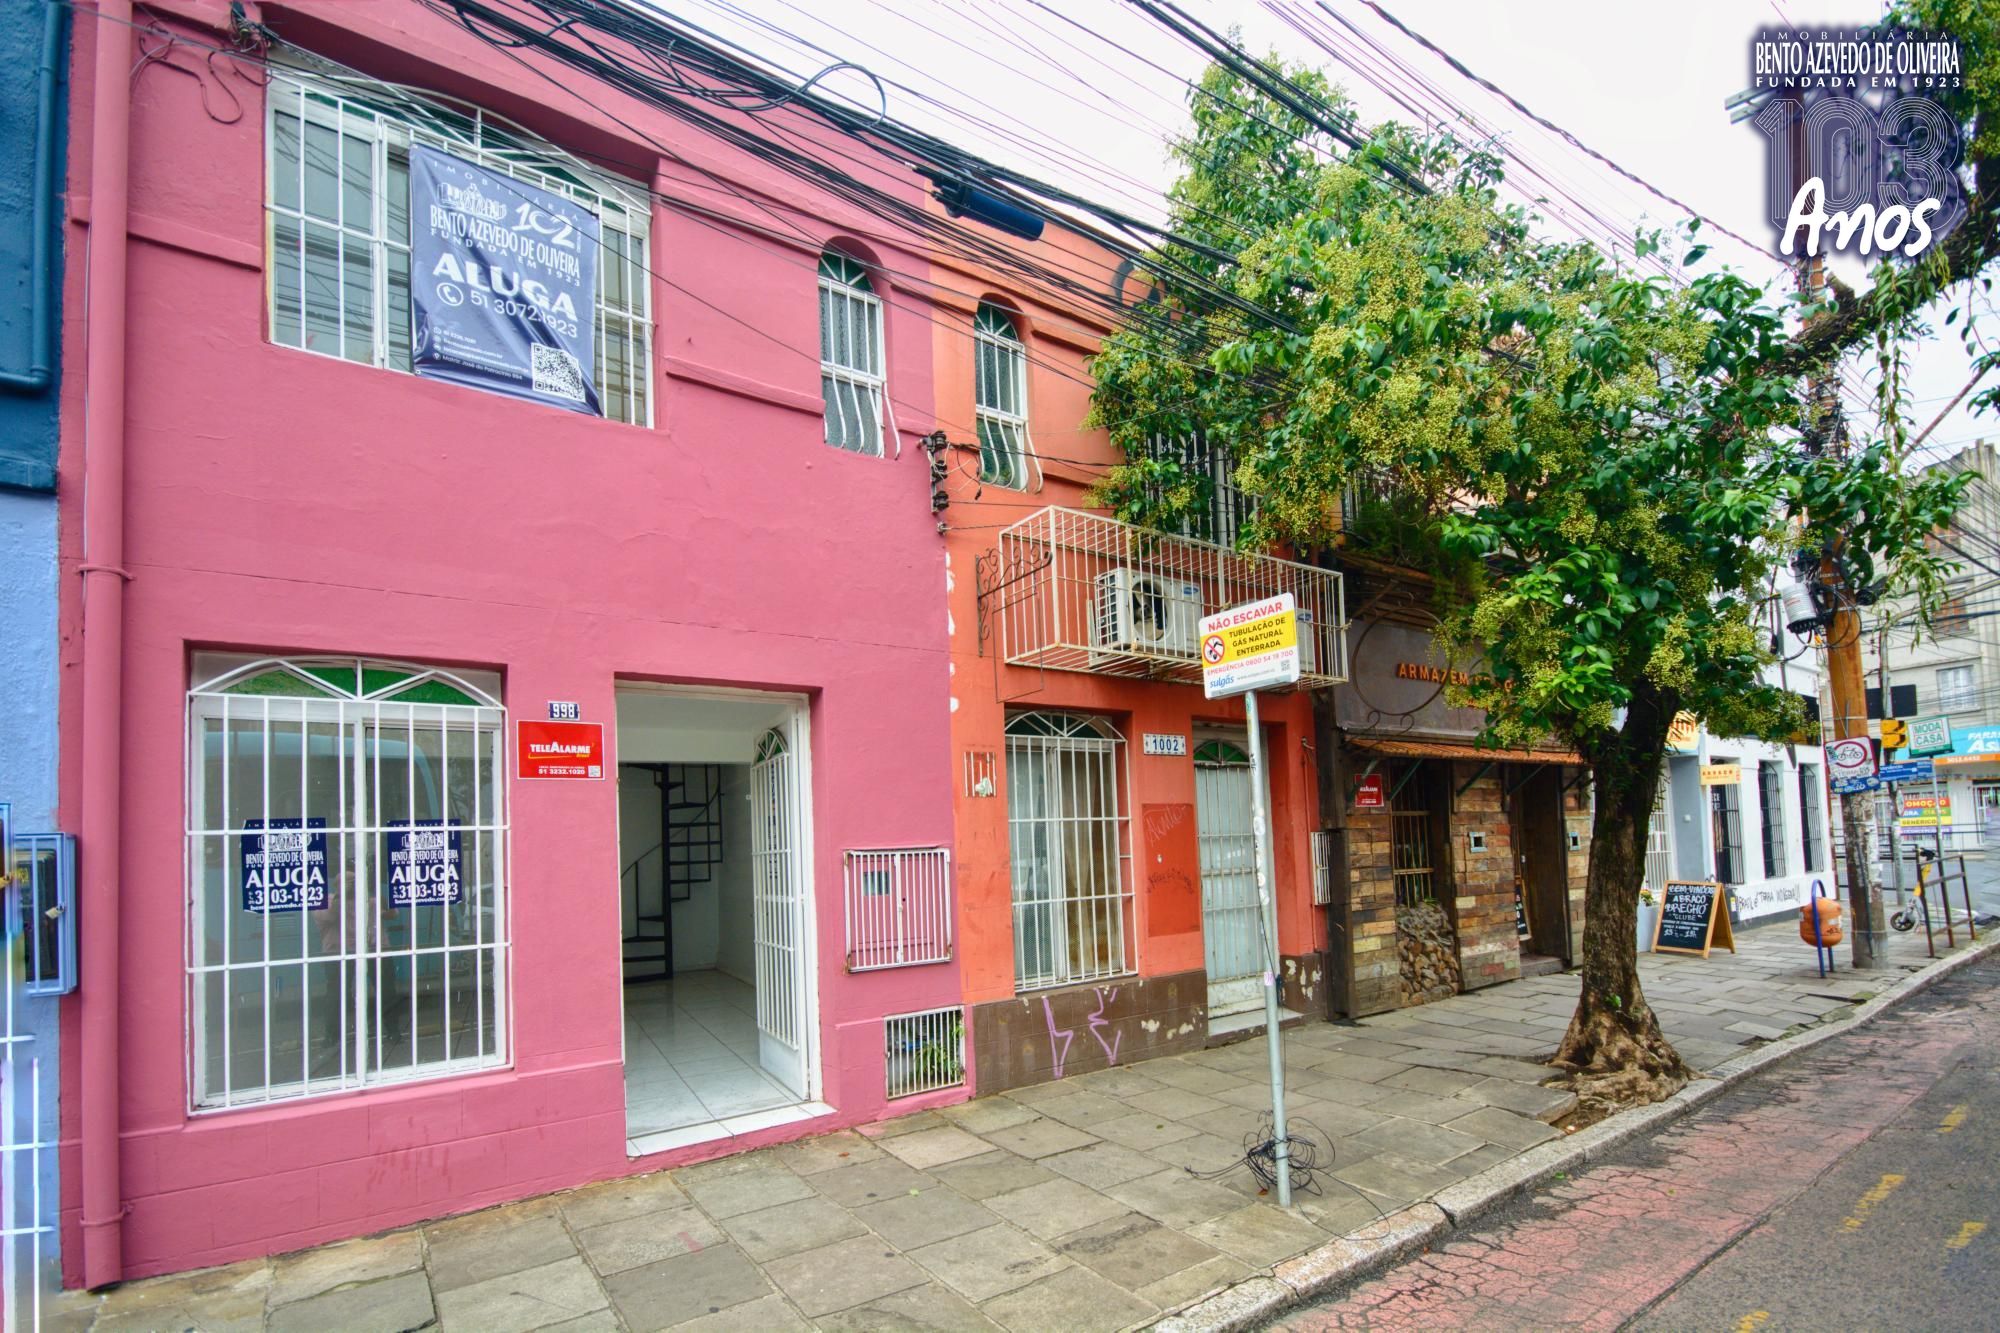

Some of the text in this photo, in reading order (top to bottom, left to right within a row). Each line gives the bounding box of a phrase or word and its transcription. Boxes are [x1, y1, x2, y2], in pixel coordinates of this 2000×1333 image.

[511, 201, 576, 250] 102
[429, 204, 467, 238] BENTO
[468, 217, 519, 253] AZEVEDO
[520, 236, 536, 261] DE
[536, 242, 581, 279] OLIVEIRA
[431, 227, 581, 287] FUNDADA EM 1923
[432, 252, 579, 322] ALUGA
[470, 289, 489, 309] 51
[1207, 601, 1284, 633] NÃO ESCAVAR
[1275, 616, 1287, 627] DE
[1248, 631, 1284, 644] NATURAL
[1236, 639, 1282, 657] ENTERRADA
[552, 703, 576, 718] 998
[1913, 722, 1942, 734] MODA
[1152, 738, 1179, 752] 1002
[1916, 733, 1944, 746] CASA
[245, 852, 265, 865] BENTO
[265, 851, 291, 863] ZEVEDO
[291, 851, 300, 862] DE
[391, 851, 408, 861] BENTO
[430, 850, 438, 860] DE
[391, 863, 460, 884] ALUGA
[254, 886, 325, 905] 303-1923
